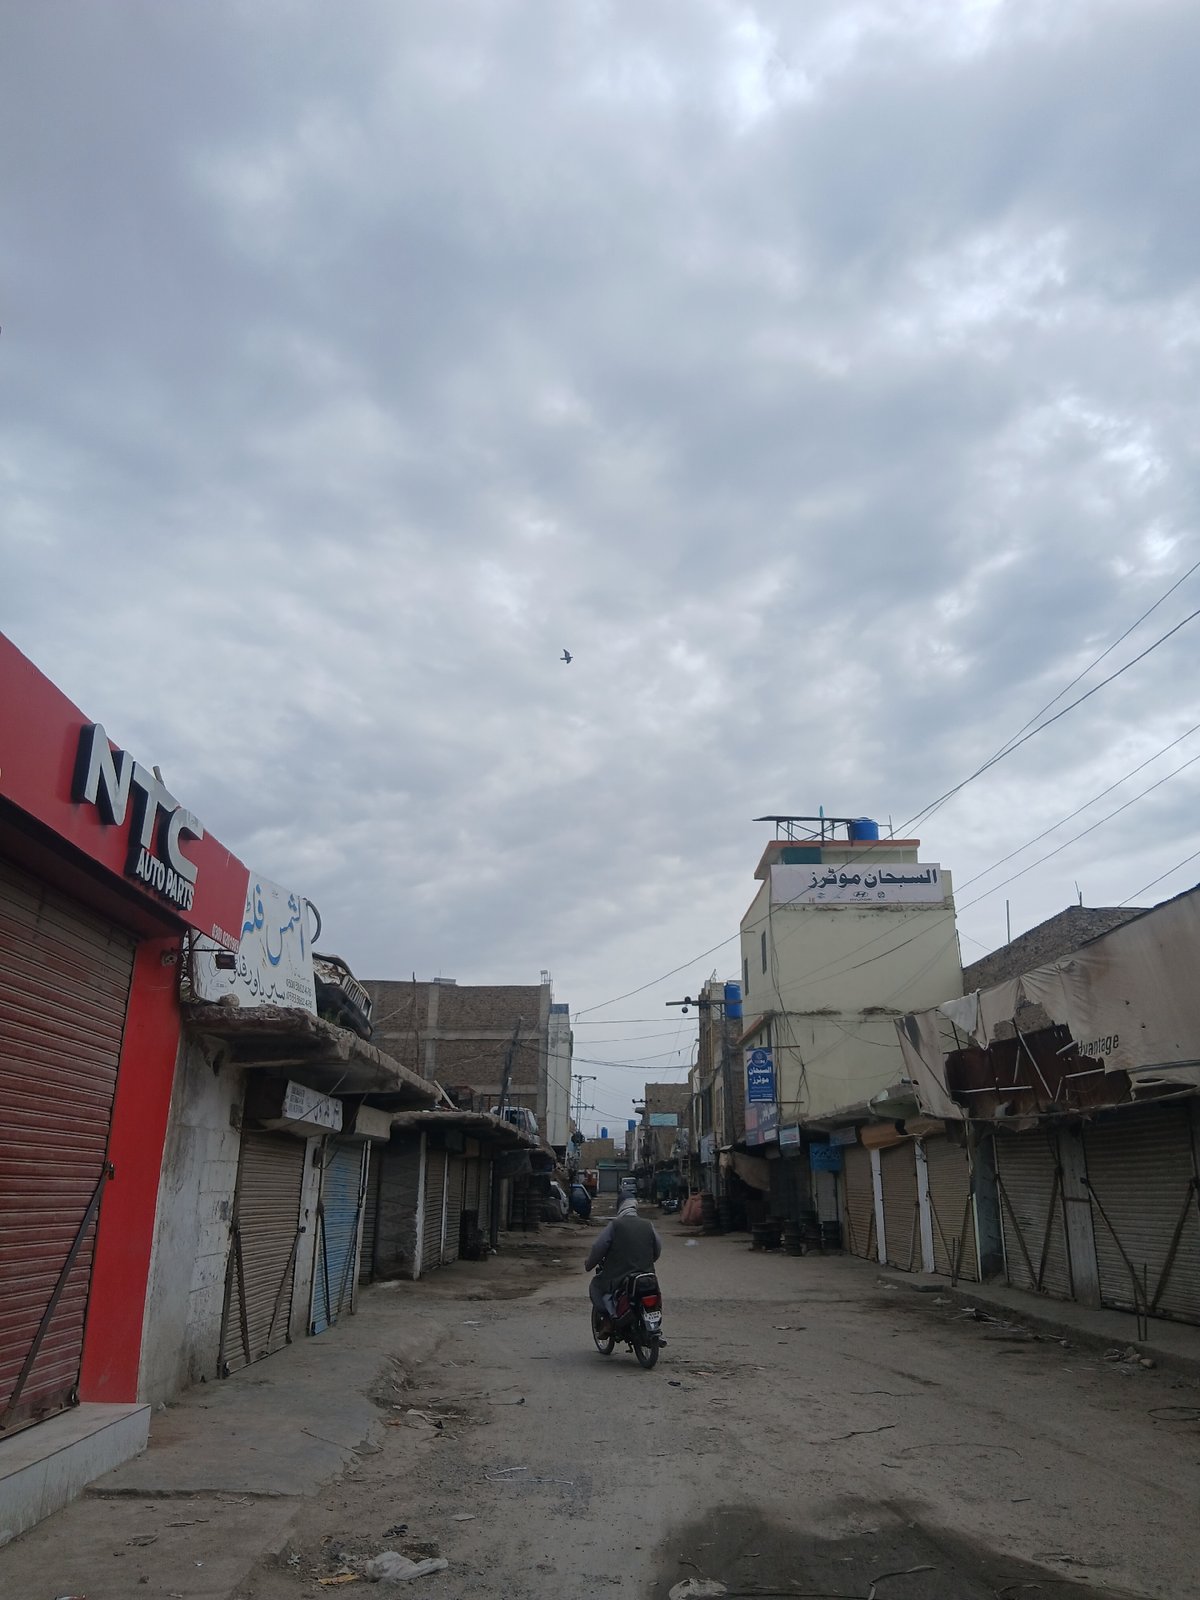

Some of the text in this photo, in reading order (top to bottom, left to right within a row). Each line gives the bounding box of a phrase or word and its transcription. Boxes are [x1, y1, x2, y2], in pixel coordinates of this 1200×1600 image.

[83, 722, 204, 885] NTC
[135, 848, 195, 912] AUTO PARTS
[807, 867, 938, 889] السبحان موٹرز
